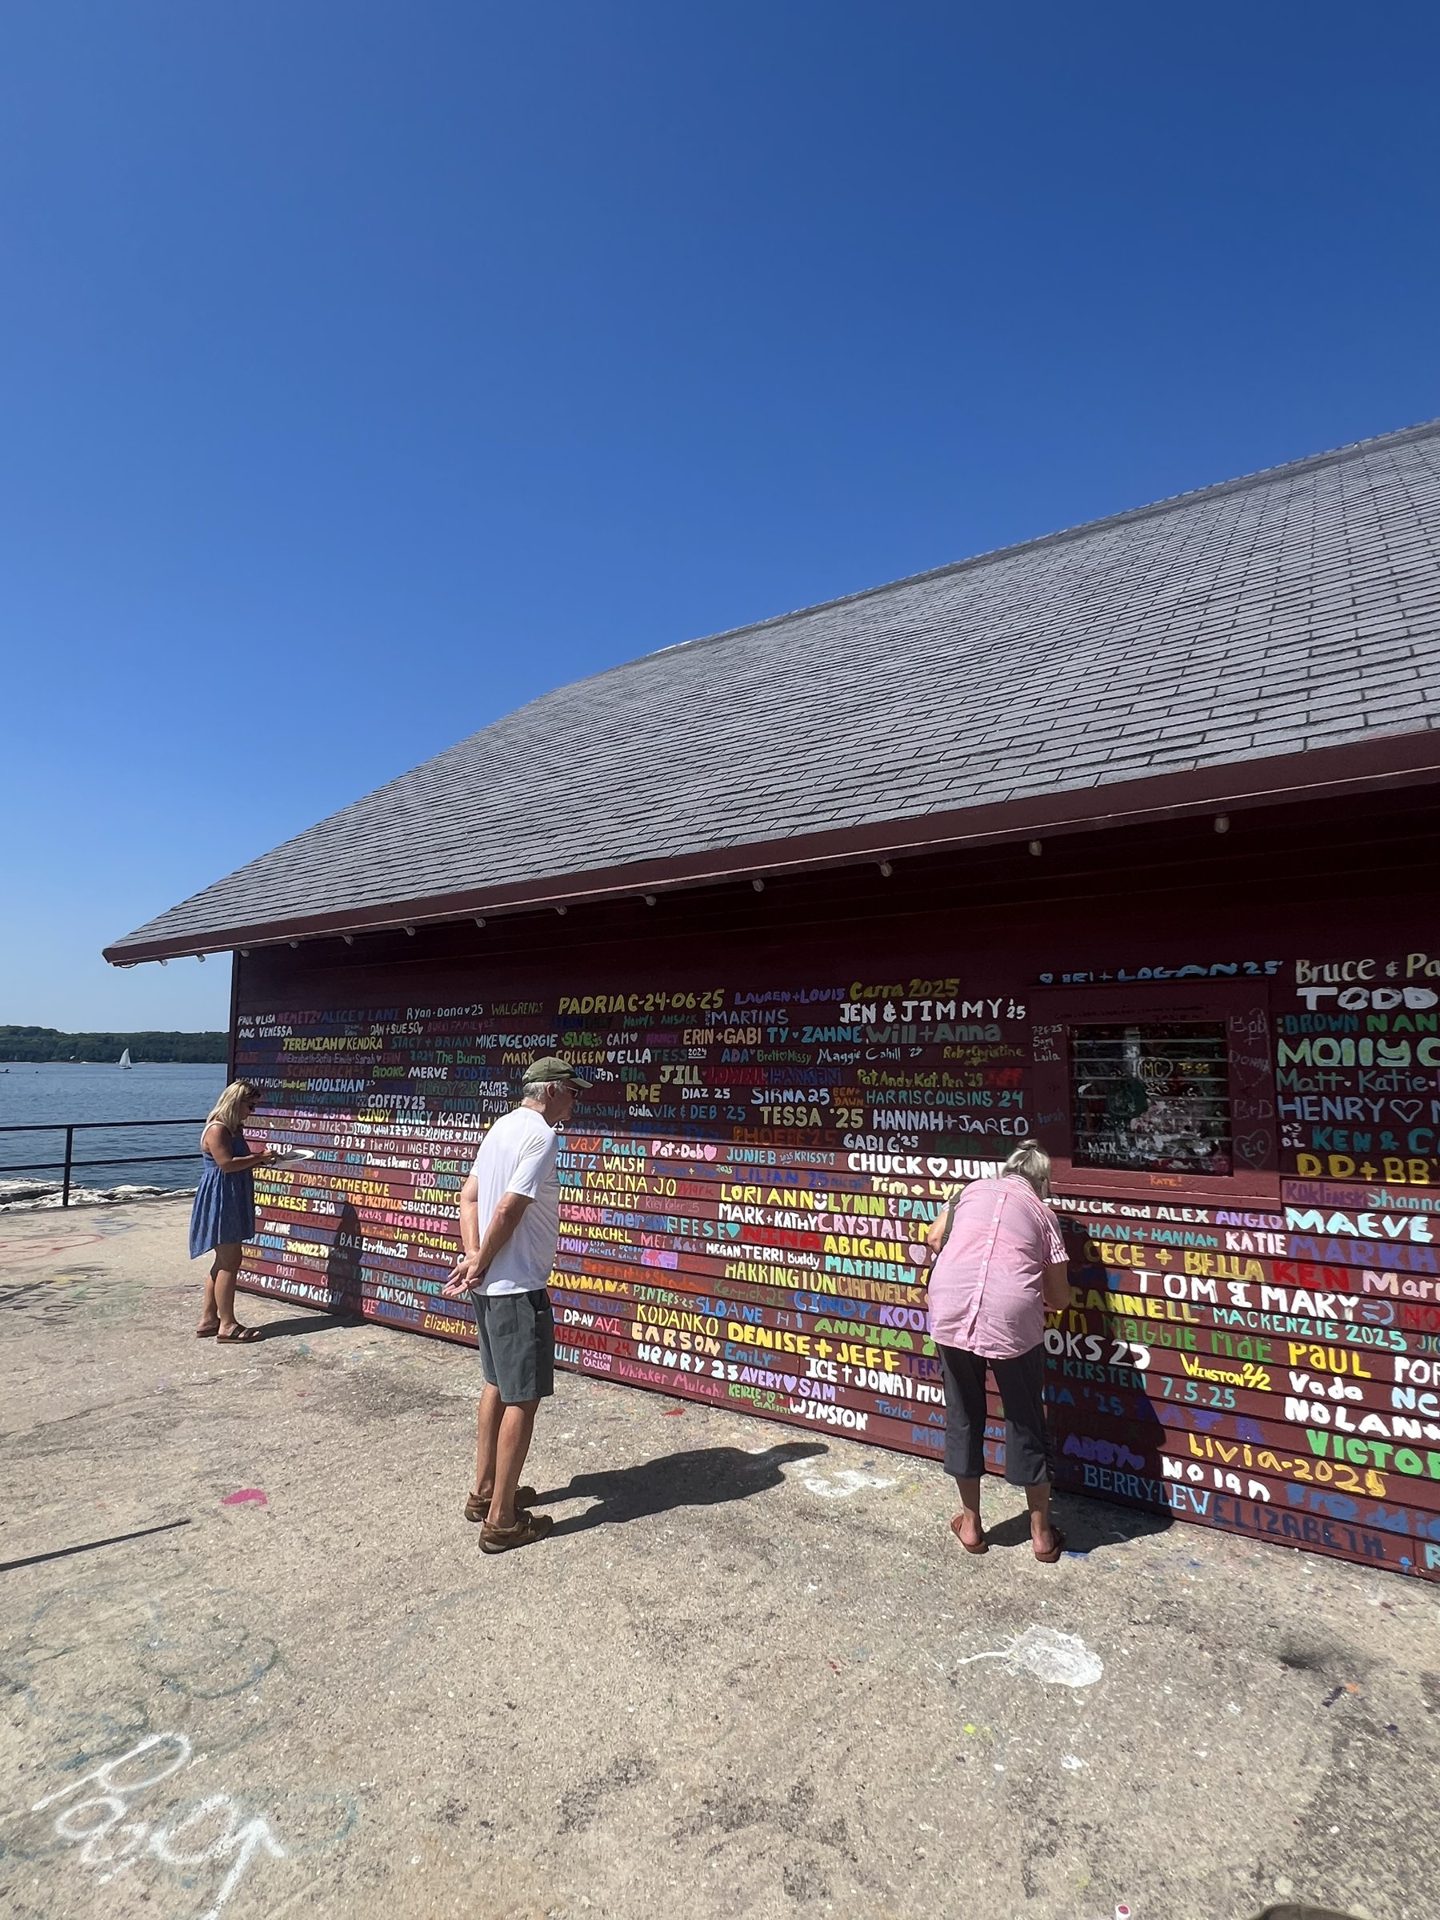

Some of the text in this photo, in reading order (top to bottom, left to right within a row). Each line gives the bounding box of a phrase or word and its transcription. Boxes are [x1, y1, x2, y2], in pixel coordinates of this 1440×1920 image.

[1296, 959, 1376, 984] Bruce
[909, 979, 960, 998] 2025
[1296, 987, 1438, 1010] TODD
[711, 1009, 789, 1025] MARTINS
[840, 1002, 876, 1023] JEN
[901, 998, 1003, 1022] JIMMY
[347, 1037, 382, 1050] KENDRA
[476, 1034, 558, 1049] MIKE GEORGIE
[436, 1050, 486, 1064] The Burns
[502, 1050, 535, 1064] MARK
[617, 1048, 651, 1063] ELLA
[408, 1067, 448, 1079] MERVE
[660, 1066, 702, 1084] JILL
[1358, 1070, 1429, 1093] Katie
[307, 1079, 365, 1092] HOOLIHAN
[682, 1088, 730, 1099] DIAZ 25
[368, 1095, 409, 1109] COFFEY
[411, 1095, 425, 1109] 25
[691, 1105, 717, 1119] DEB
[1278, 1096, 1385, 1122] HENRY
[357, 1109, 480, 1128] CINDY NANCY KAREN
[760, 1107, 822, 1127] TESSA
[1313, 1126, 1371, 1151] KEN
[603, 1156, 645, 1173] WALSH
[848, 1153, 923, 1174] CHUCK
[330, 1176, 390, 1195] CATHERINE
[586, 1171, 676, 1195] KARINA JO
[594, 1192, 639, 1209] HAILEY
[828, 1194, 885, 1216] LYNN
[1062, 1198, 1209, 1223] NICK and ALEX
[719, 1203, 764, 1225] MARK
[1286, 1207, 1434, 1242] MAEVE
[667, 1216, 726, 1239] REESE
[818, 1213, 908, 1241] CRYSTAL
[824, 1234, 905, 1262] ABIGAIL
[1226, 1230, 1287, 1254] KATIE
[725, 1261, 837, 1294] HARRINGTON
[1184, 1251, 1265, 1282] BELLA
[1271, 1260, 1350, 1289] KEN
[376, 1286, 414, 1305] MASON
[794, 1292, 871, 1318] CINDY
[1132, 1270, 1216, 1303] TOM
[1261, 1285, 1360, 1321] MARY
[424, 1314, 467, 1335] Elizabeth
[637, 1304, 719, 1336] KODANKO
[1213, 1308, 1407, 1351] MACKENZIE 2025
[632, 1322, 720, 1356] CARSON
[815, 1317, 913, 1350] ANNIKA
[728, 1322, 811, 1355] DENISE
[837, 1343, 900, 1372] JEFF
[1110, 1340, 1150, 1370] 25
[711, 1363, 738, 1380] 25
[1063, 1359, 1147, 1390] KIRSTEN
[739, 1367, 783, 1389] AVERY
[798, 1378, 835, 1401] SAM
[790, 1396, 868, 1431] WINSTON
[1213, 1496, 1385, 1559] ELIZABETH
